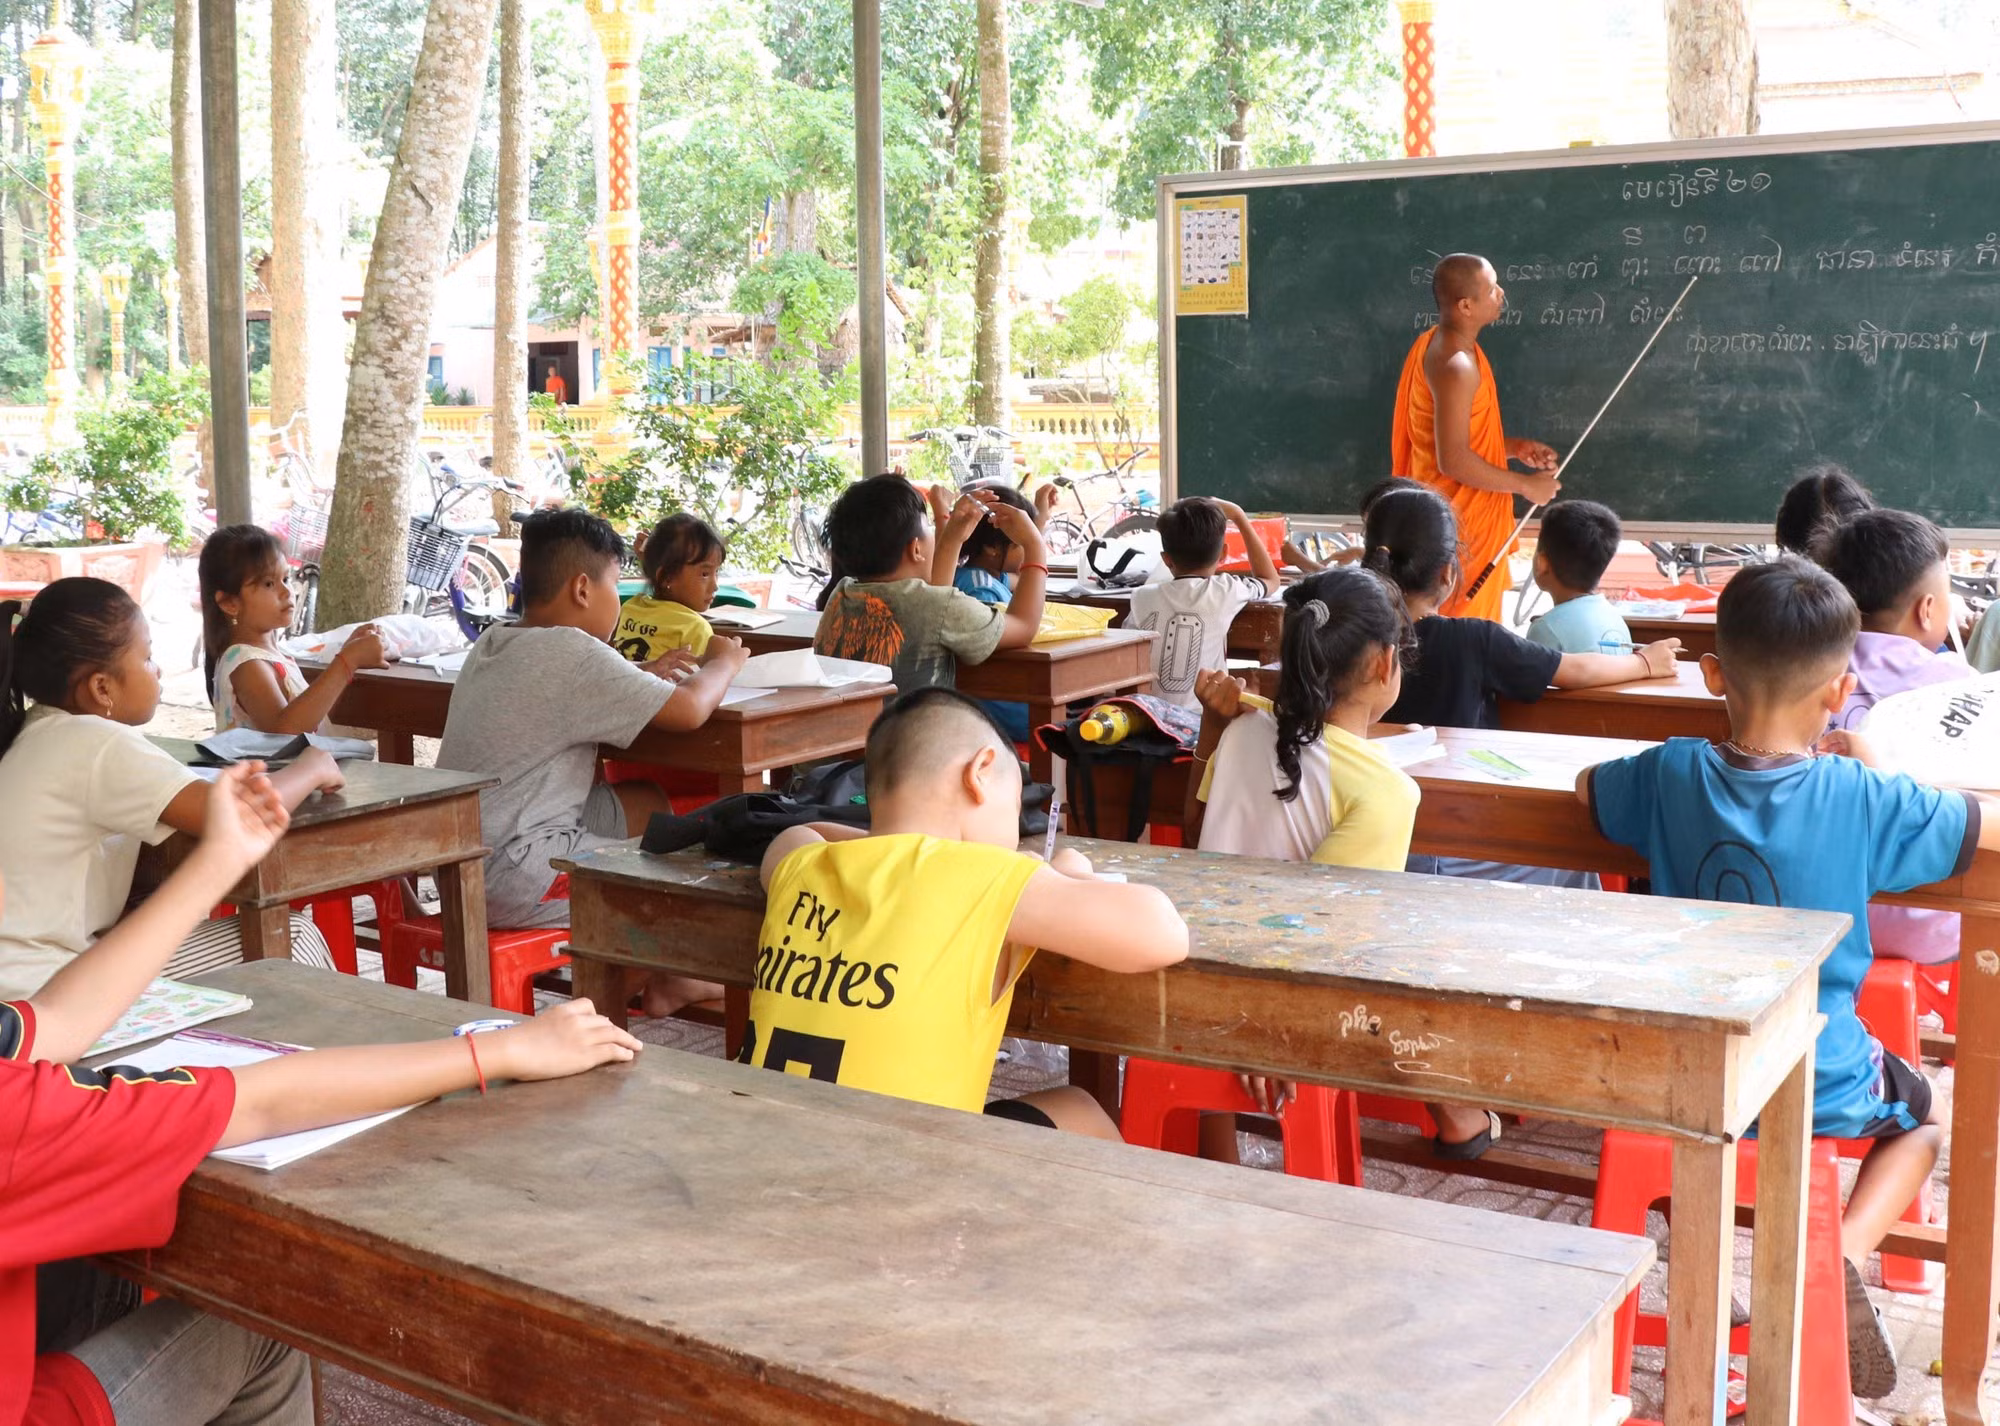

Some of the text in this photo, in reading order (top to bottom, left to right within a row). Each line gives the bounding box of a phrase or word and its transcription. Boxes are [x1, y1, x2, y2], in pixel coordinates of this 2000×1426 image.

[1622, 225, 1707, 247] ន ព
[1506, 262, 1543, 282] នេះ
[787, 890, 841, 942] Fly
